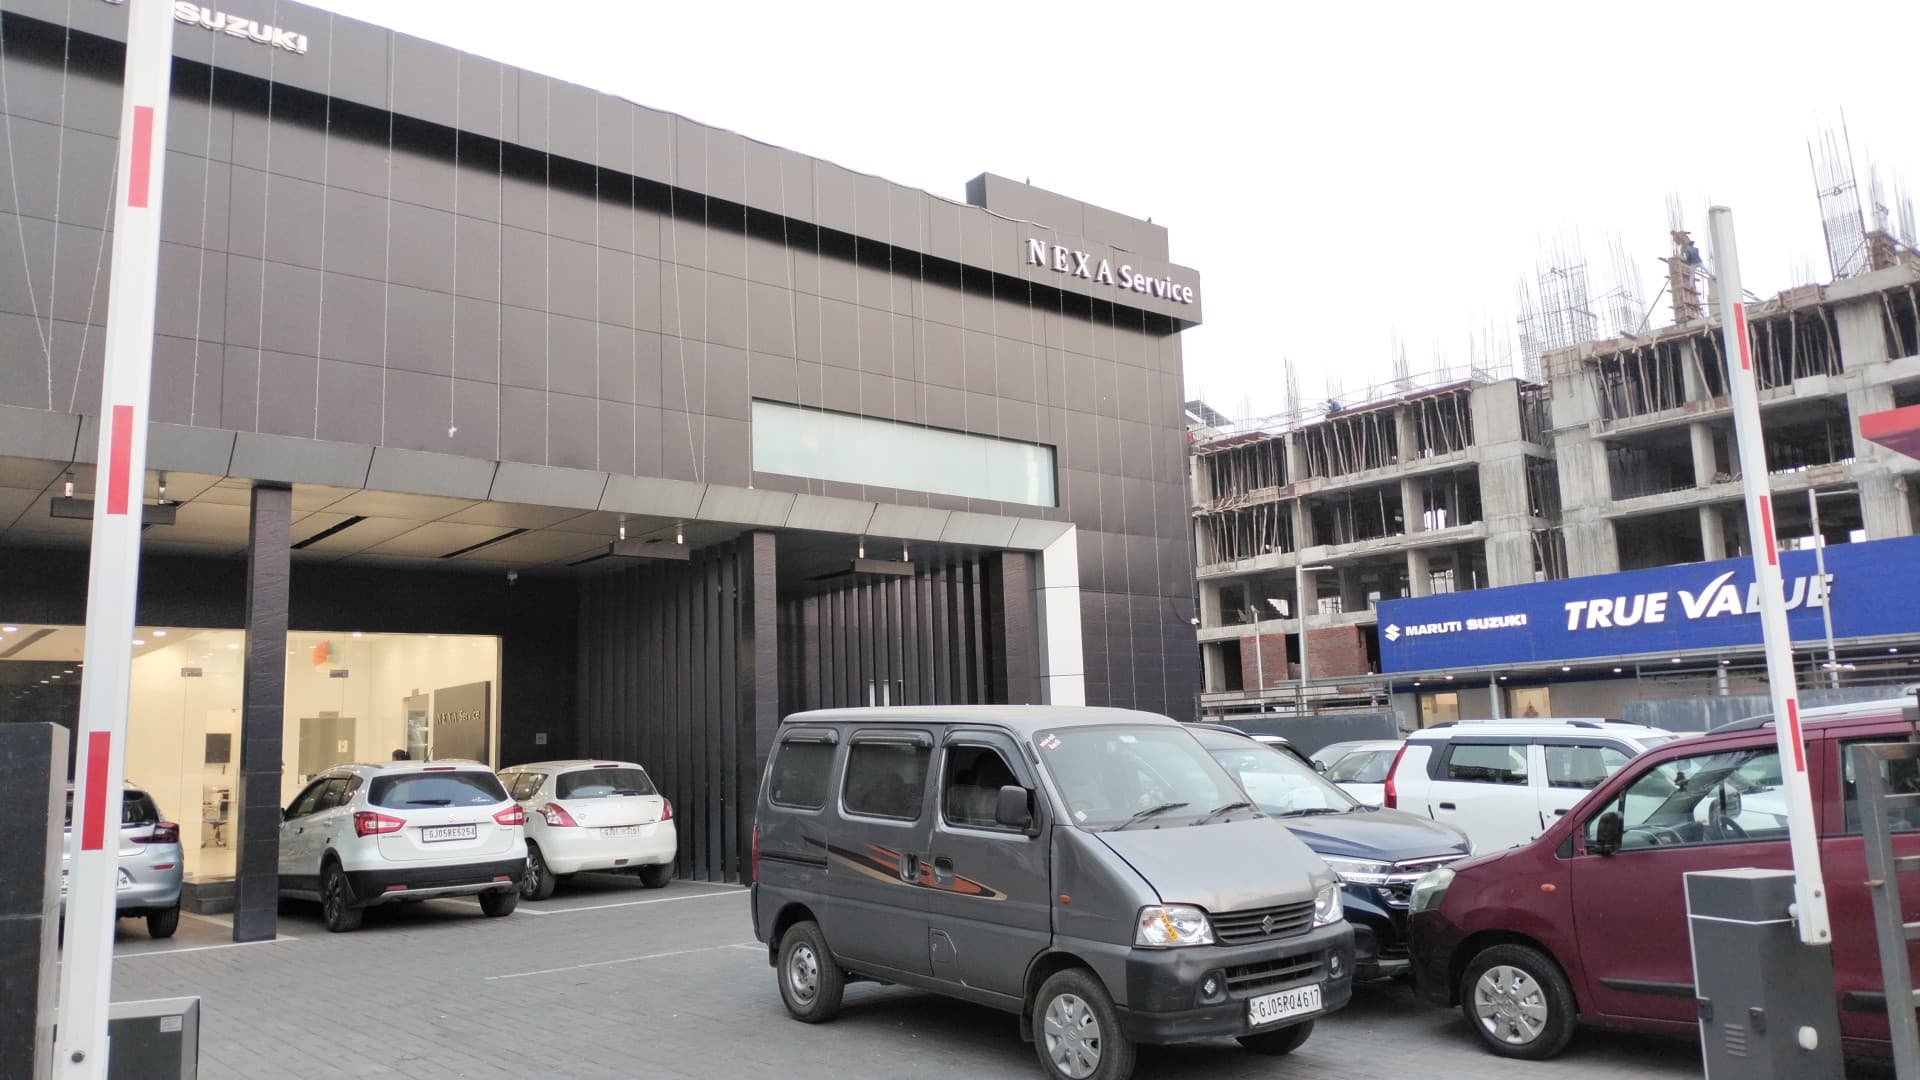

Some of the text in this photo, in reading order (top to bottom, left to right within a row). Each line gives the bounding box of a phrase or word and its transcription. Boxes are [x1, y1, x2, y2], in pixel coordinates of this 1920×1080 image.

[174, 1, 308, 55] SUZUKI
[1027, 238, 1193, 304] NEXA Service
[1405, 614, 1527, 636] MARUTI SUZUKI
[1564, 591, 1668, 631] TRUE
[1259, 988, 1319, 1018] GJ05RQ4617
